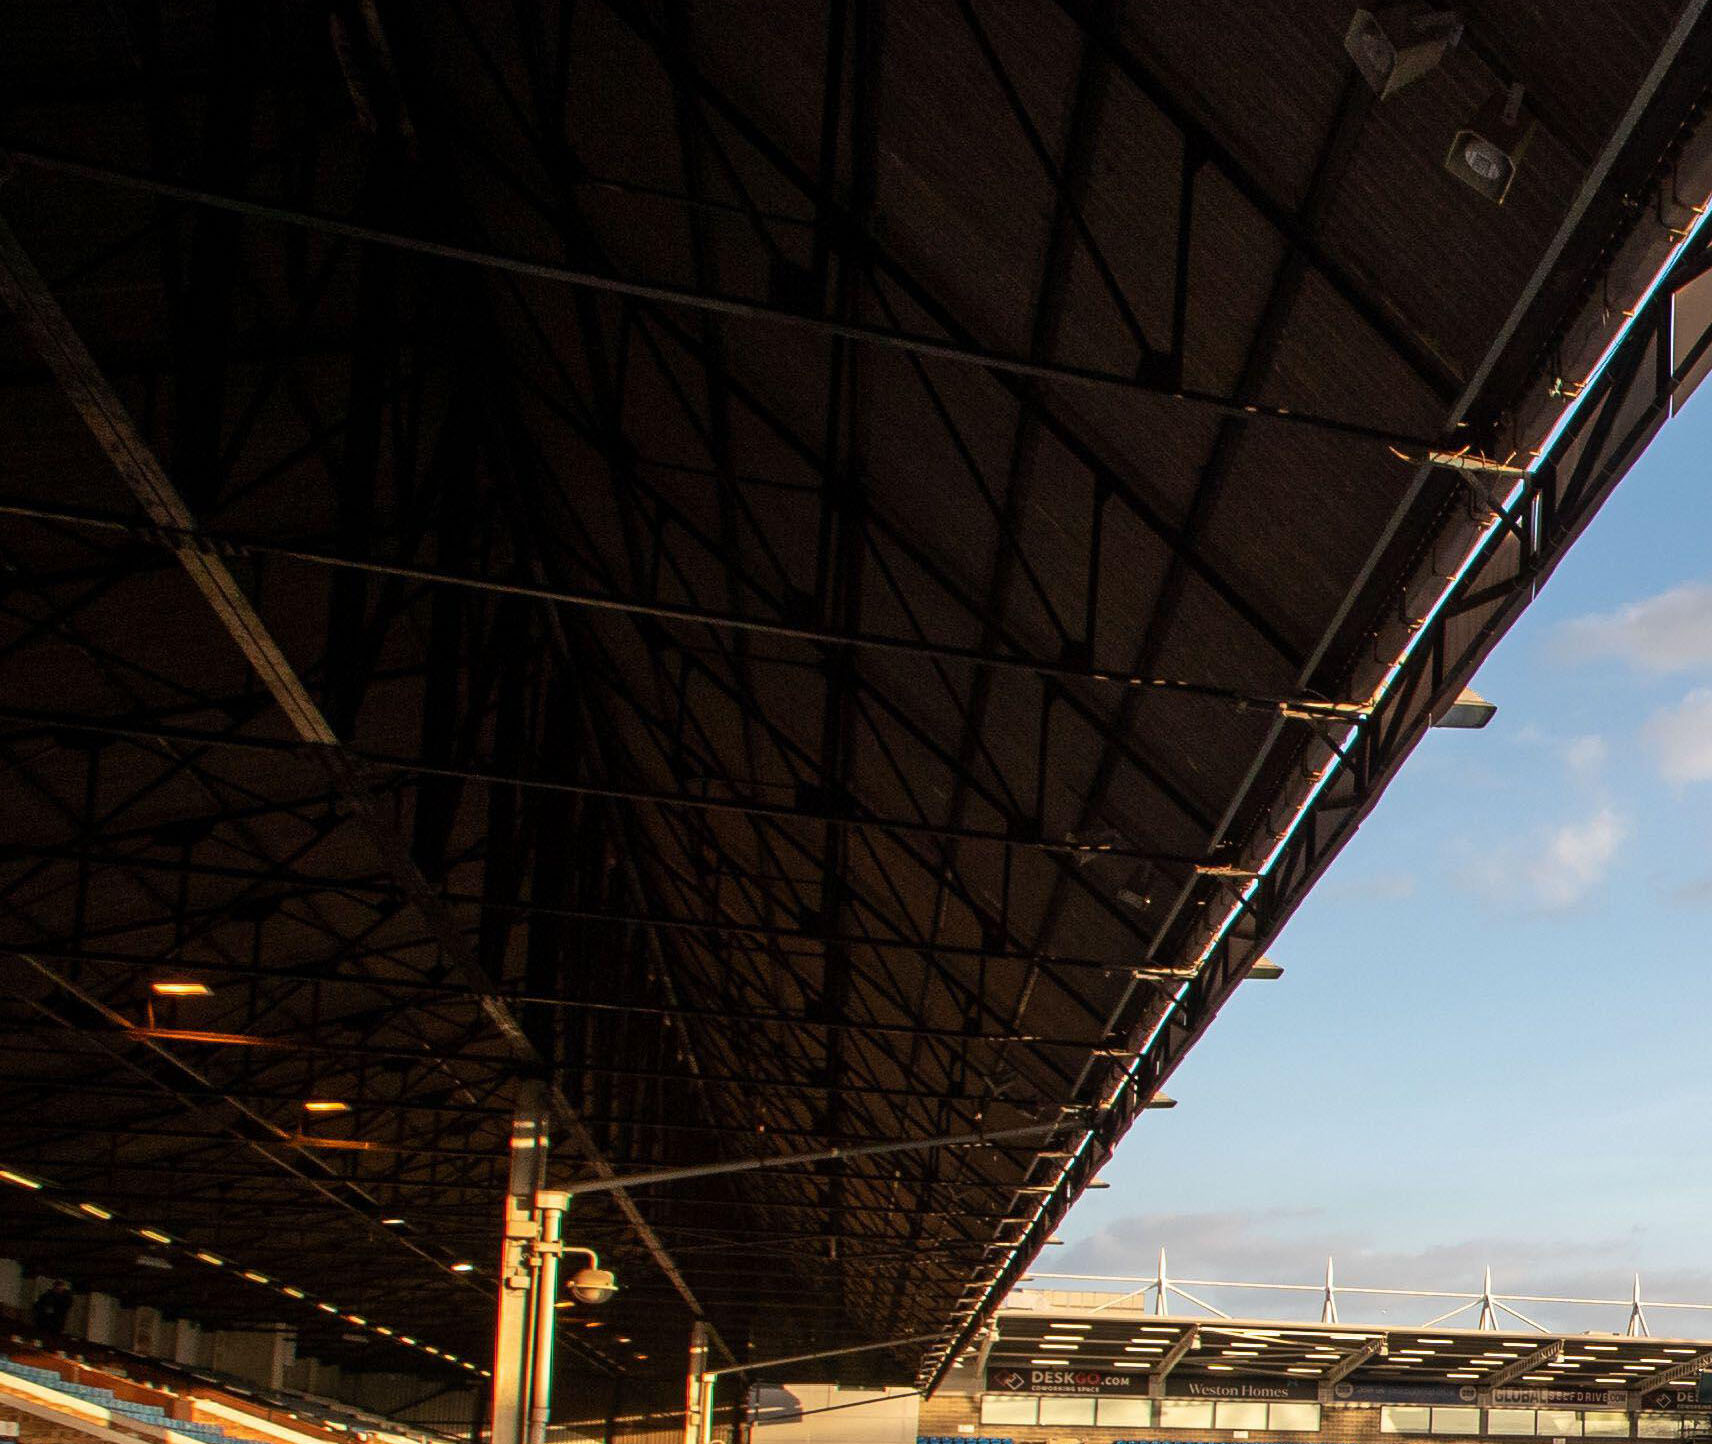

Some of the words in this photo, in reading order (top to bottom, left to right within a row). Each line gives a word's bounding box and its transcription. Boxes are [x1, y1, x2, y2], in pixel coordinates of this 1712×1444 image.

[1031, 1371, 1130, 1386] DESKGO.COM
[1188, 1383, 1239, 1396] Weston
[1241, 1384, 1289, 1398] Homes
